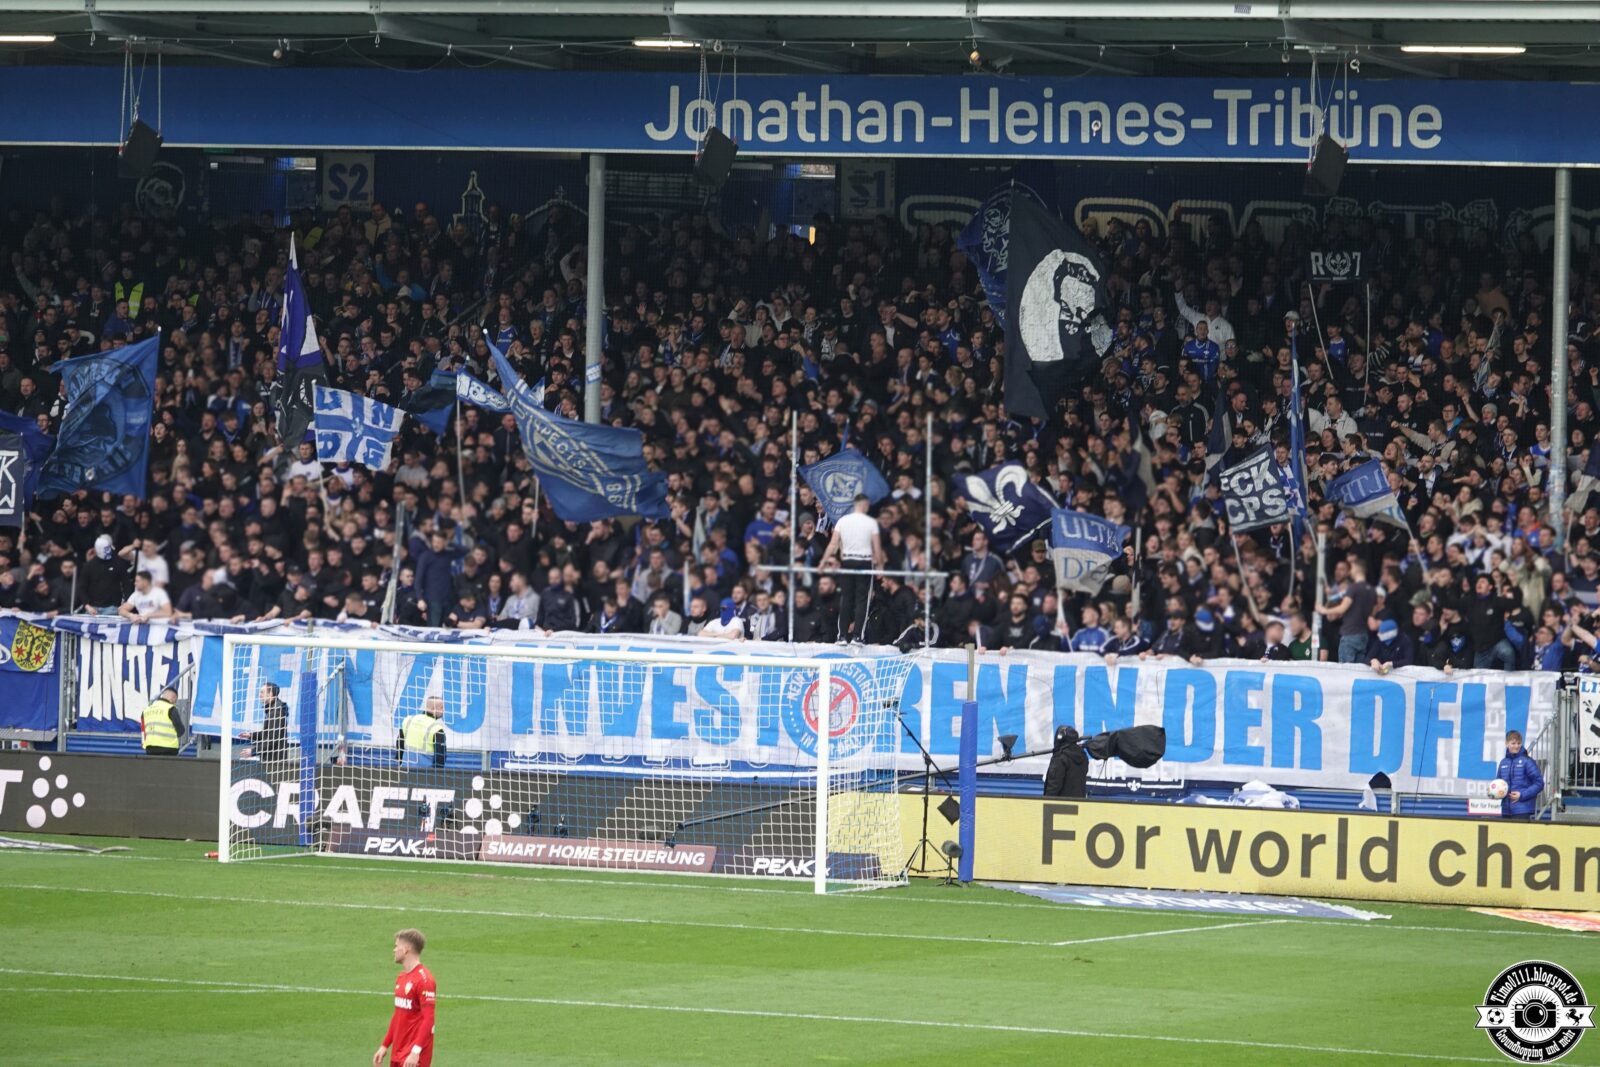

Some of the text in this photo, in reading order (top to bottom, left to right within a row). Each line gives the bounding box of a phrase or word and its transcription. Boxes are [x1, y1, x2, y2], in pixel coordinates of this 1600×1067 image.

[644, 83, 1443, 149] Jonathan-Heimes-Tribüne
[328, 162, 370, 200] S2
[392, 641, 487, 734] ZU
[1053, 665, 1139, 758] IN
[1162, 668, 1324, 771] DER
[229, 778, 456, 832] CRAFT
[487, 841, 706, 866] SMART HOME STEUERUNG
[1042, 803, 1161, 870] For
[1186, 817, 1399, 883] world
